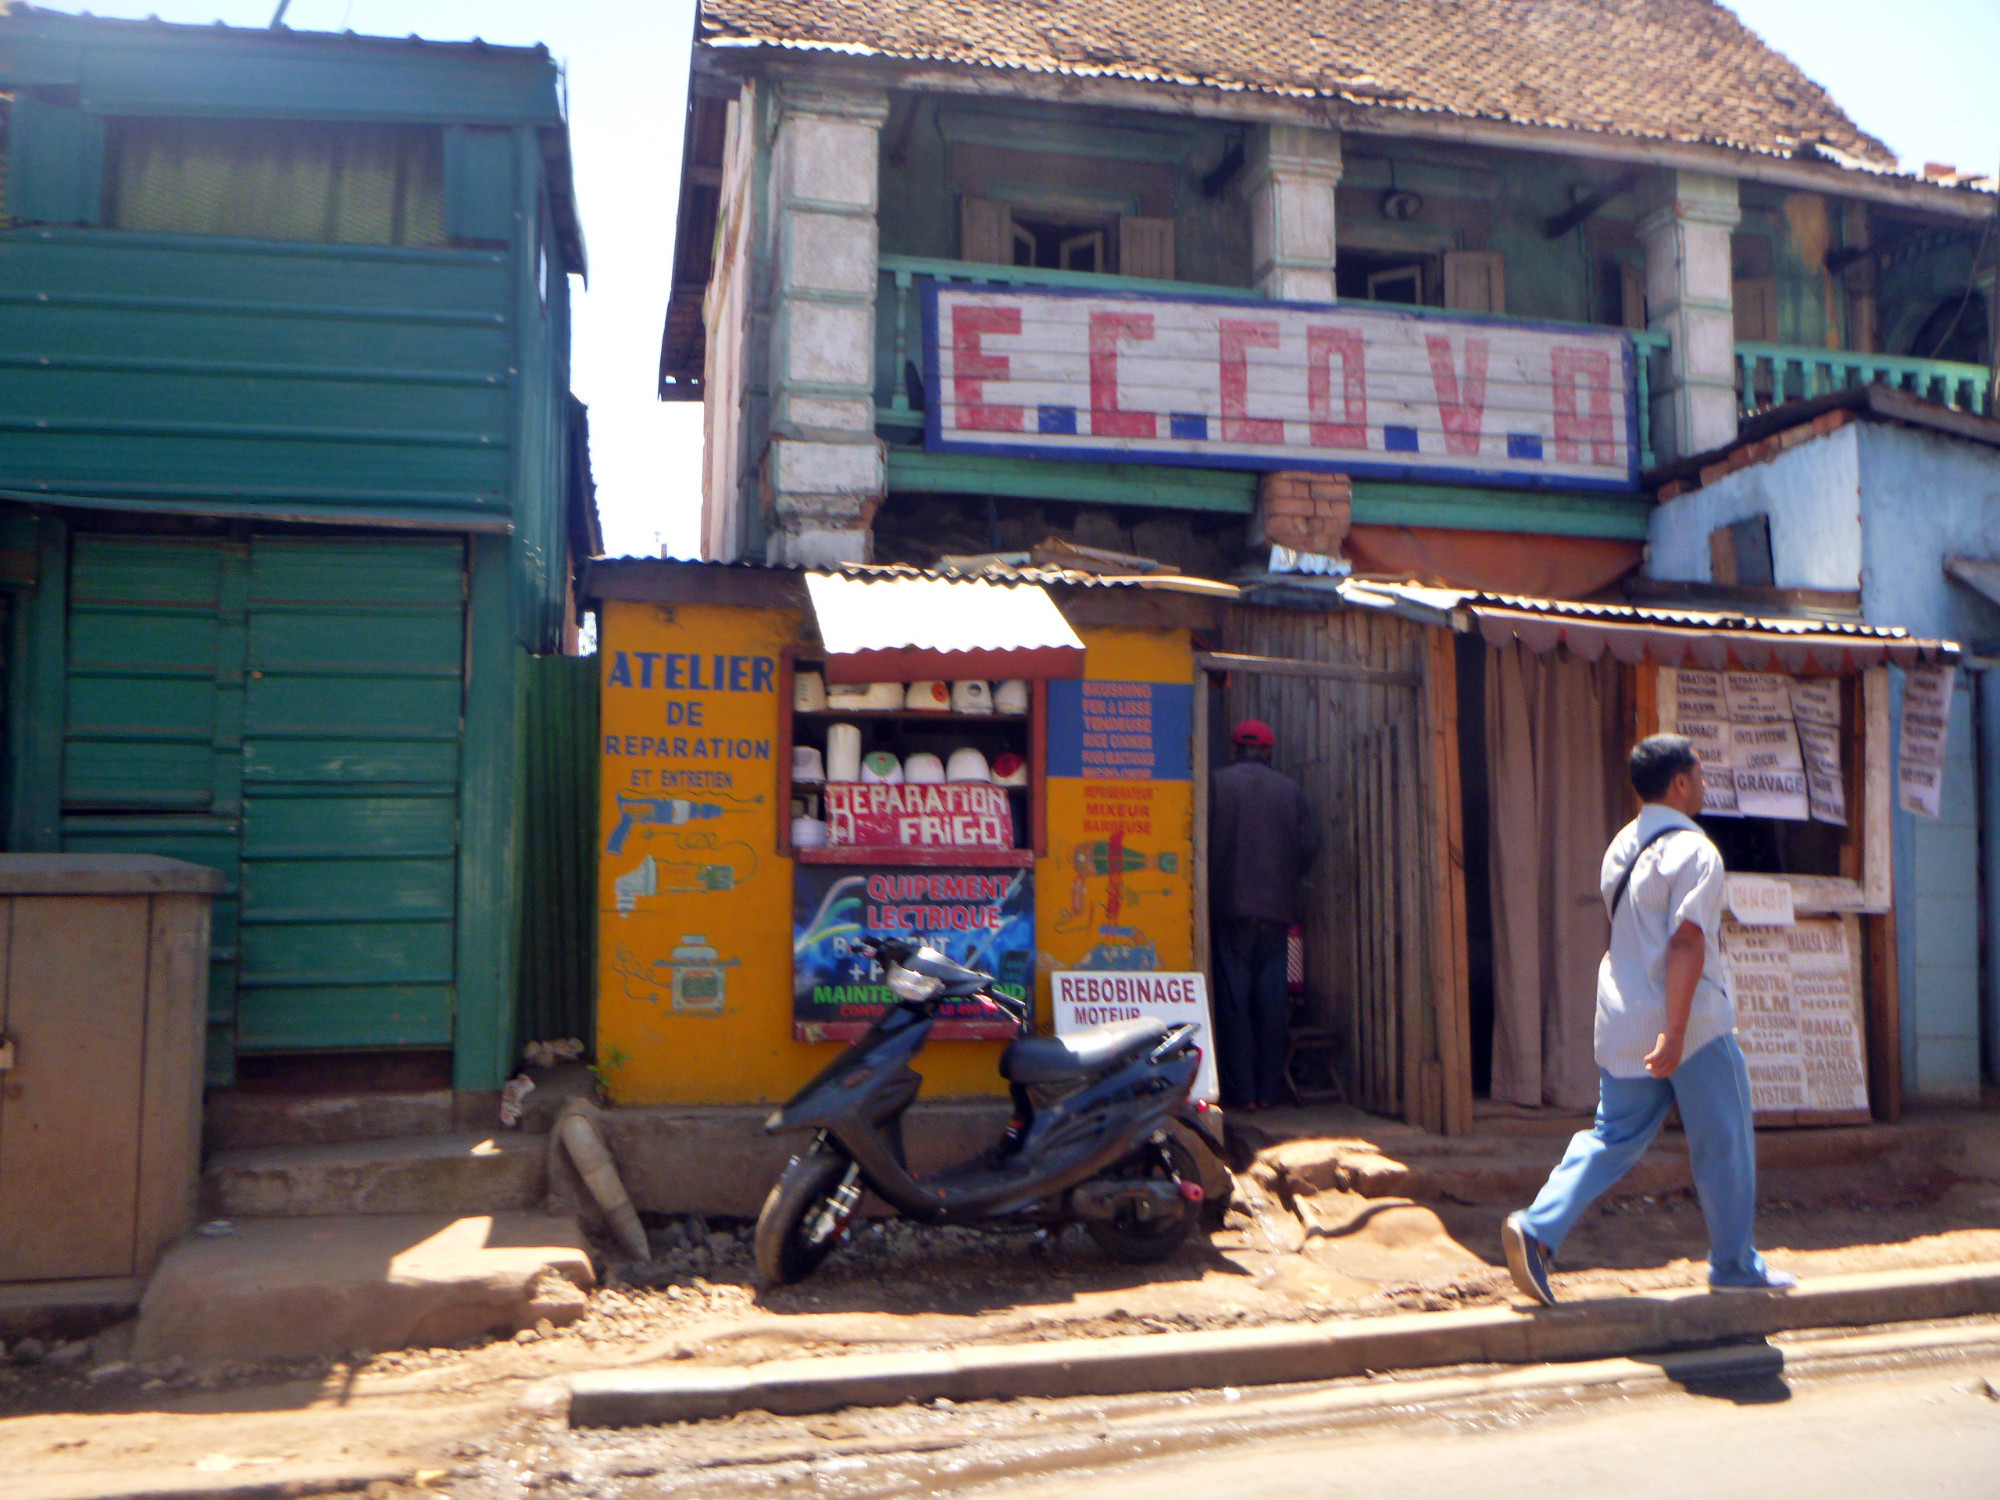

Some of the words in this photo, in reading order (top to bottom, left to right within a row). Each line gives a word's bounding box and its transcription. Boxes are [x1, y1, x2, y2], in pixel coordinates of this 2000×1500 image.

[607, 651, 775, 693] ATELIER
[667, 701, 704, 727] DE
[604, 735, 770, 760] REPARATION
[631, 769, 652, 787] ET
[661, 769, 733, 788] ENTRETIEN
[1737, 773, 1805, 795] GRAVAGE
[1085, 803, 1151, 818] MIXEUR
[1732, 951, 1788, 964] VISITE
[1060, 977, 1197, 1004] REBOBINAGE
[1737, 995, 1791, 1013] FILM
[1800, 998, 1851, 1011] NOIR
[1074, 1006, 1142, 1025] MOTEUR
[1801, 1019, 1852, 1037] MANAO
